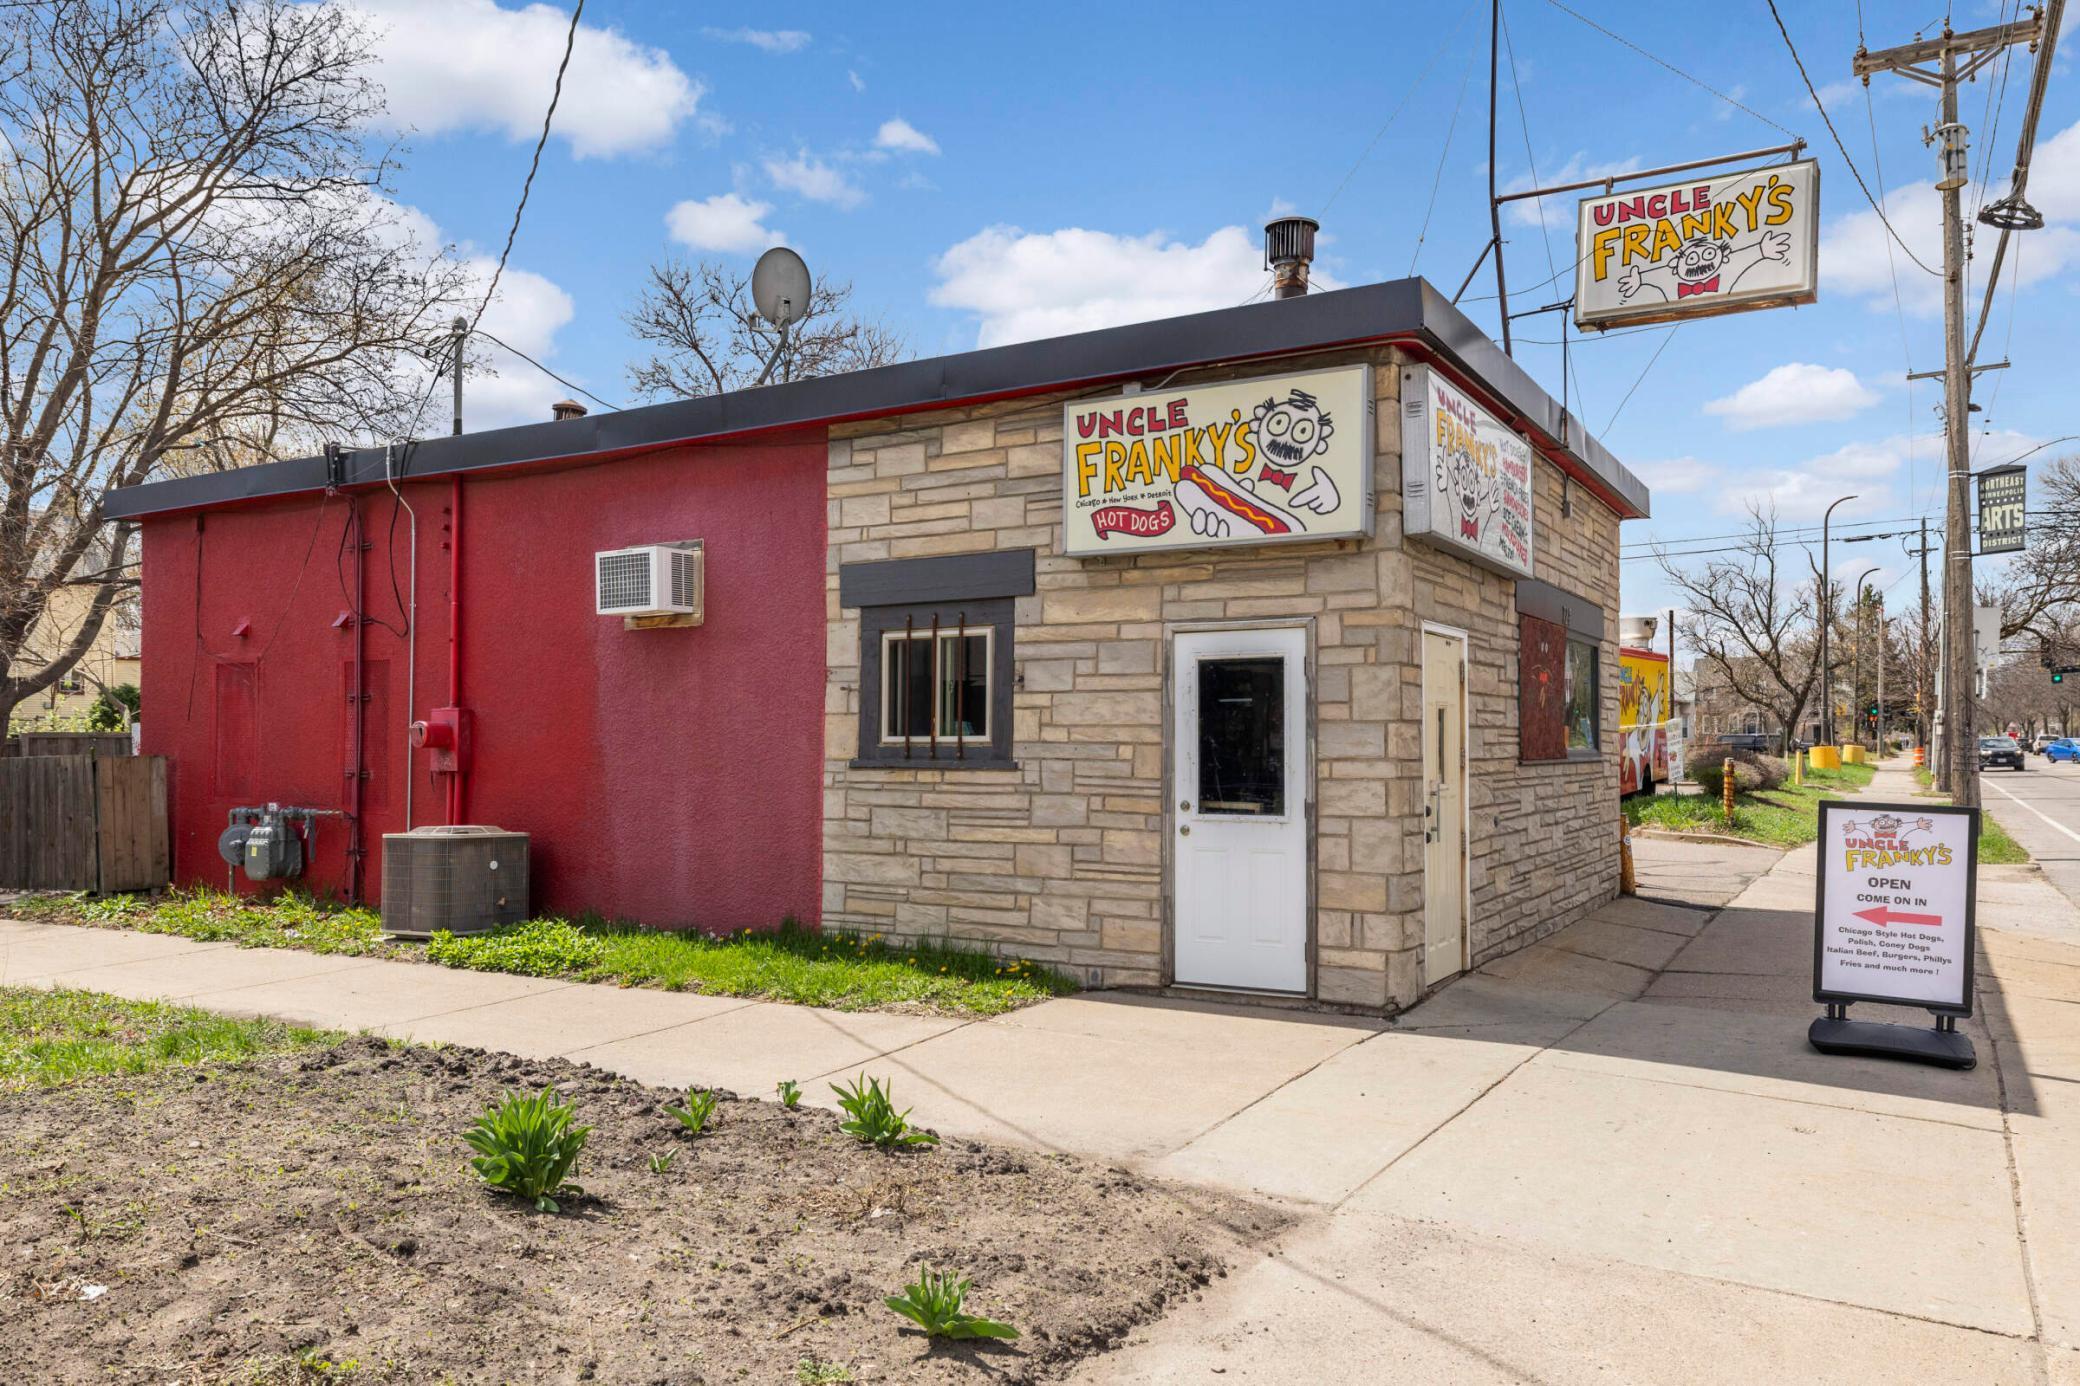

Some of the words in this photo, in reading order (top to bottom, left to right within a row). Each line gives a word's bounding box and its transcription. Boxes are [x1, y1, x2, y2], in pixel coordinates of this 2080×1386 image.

[1594, 185, 1711, 226] UNCLE
[1593, 174, 1795, 282] FRANKY'S
[1076, 398, 1188, 438] UNCLE
[1437, 386, 1476, 435] UNCLE
[1076, 408, 1256, 498] FRANKY'S
[1436, 408, 1498, 478] FRANKY'S
[1096, 511, 1128, 528] HOT
[1131, 511, 1170, 531] DOGS
[1981, 503, 2024, 532] ARTS
[1982, 536, 2022, 548] DISTRICT
[1845, 838, 1909, 852] UNCLE
[1846, 843, 1952, 872] FRANKY'S
[1868, 877, 1911, 890] OPEN
[1857, 894, 1890, 904] COME
[1894, 896, 1910, 905] ON
[1914, 898, 1927, 906] IN
[1838, 926, 1872, 936] Chicago
[1875, 929, 1898, 938] Style
[1900, 931, 1916, 940] Hot
[1920, 933, 1944, 943] Dogs,
[1848, 938, 1876, 947] Polish,
[1879, 940, 1905, 950] Coney
[1908, 942, 1930, 952] Dogs
[1826, 946, 1854, 955] Italian
[1856, 949, 1880, 958] Beef,
[1882, 952, 1921, 961] Burgers,
[1924, 954, 1952, 965] Phillys
[1840, 960, 1862, 968] Fries
[1864, 962, 1880, 970] and
[1883, 965, 1907, 973] much
